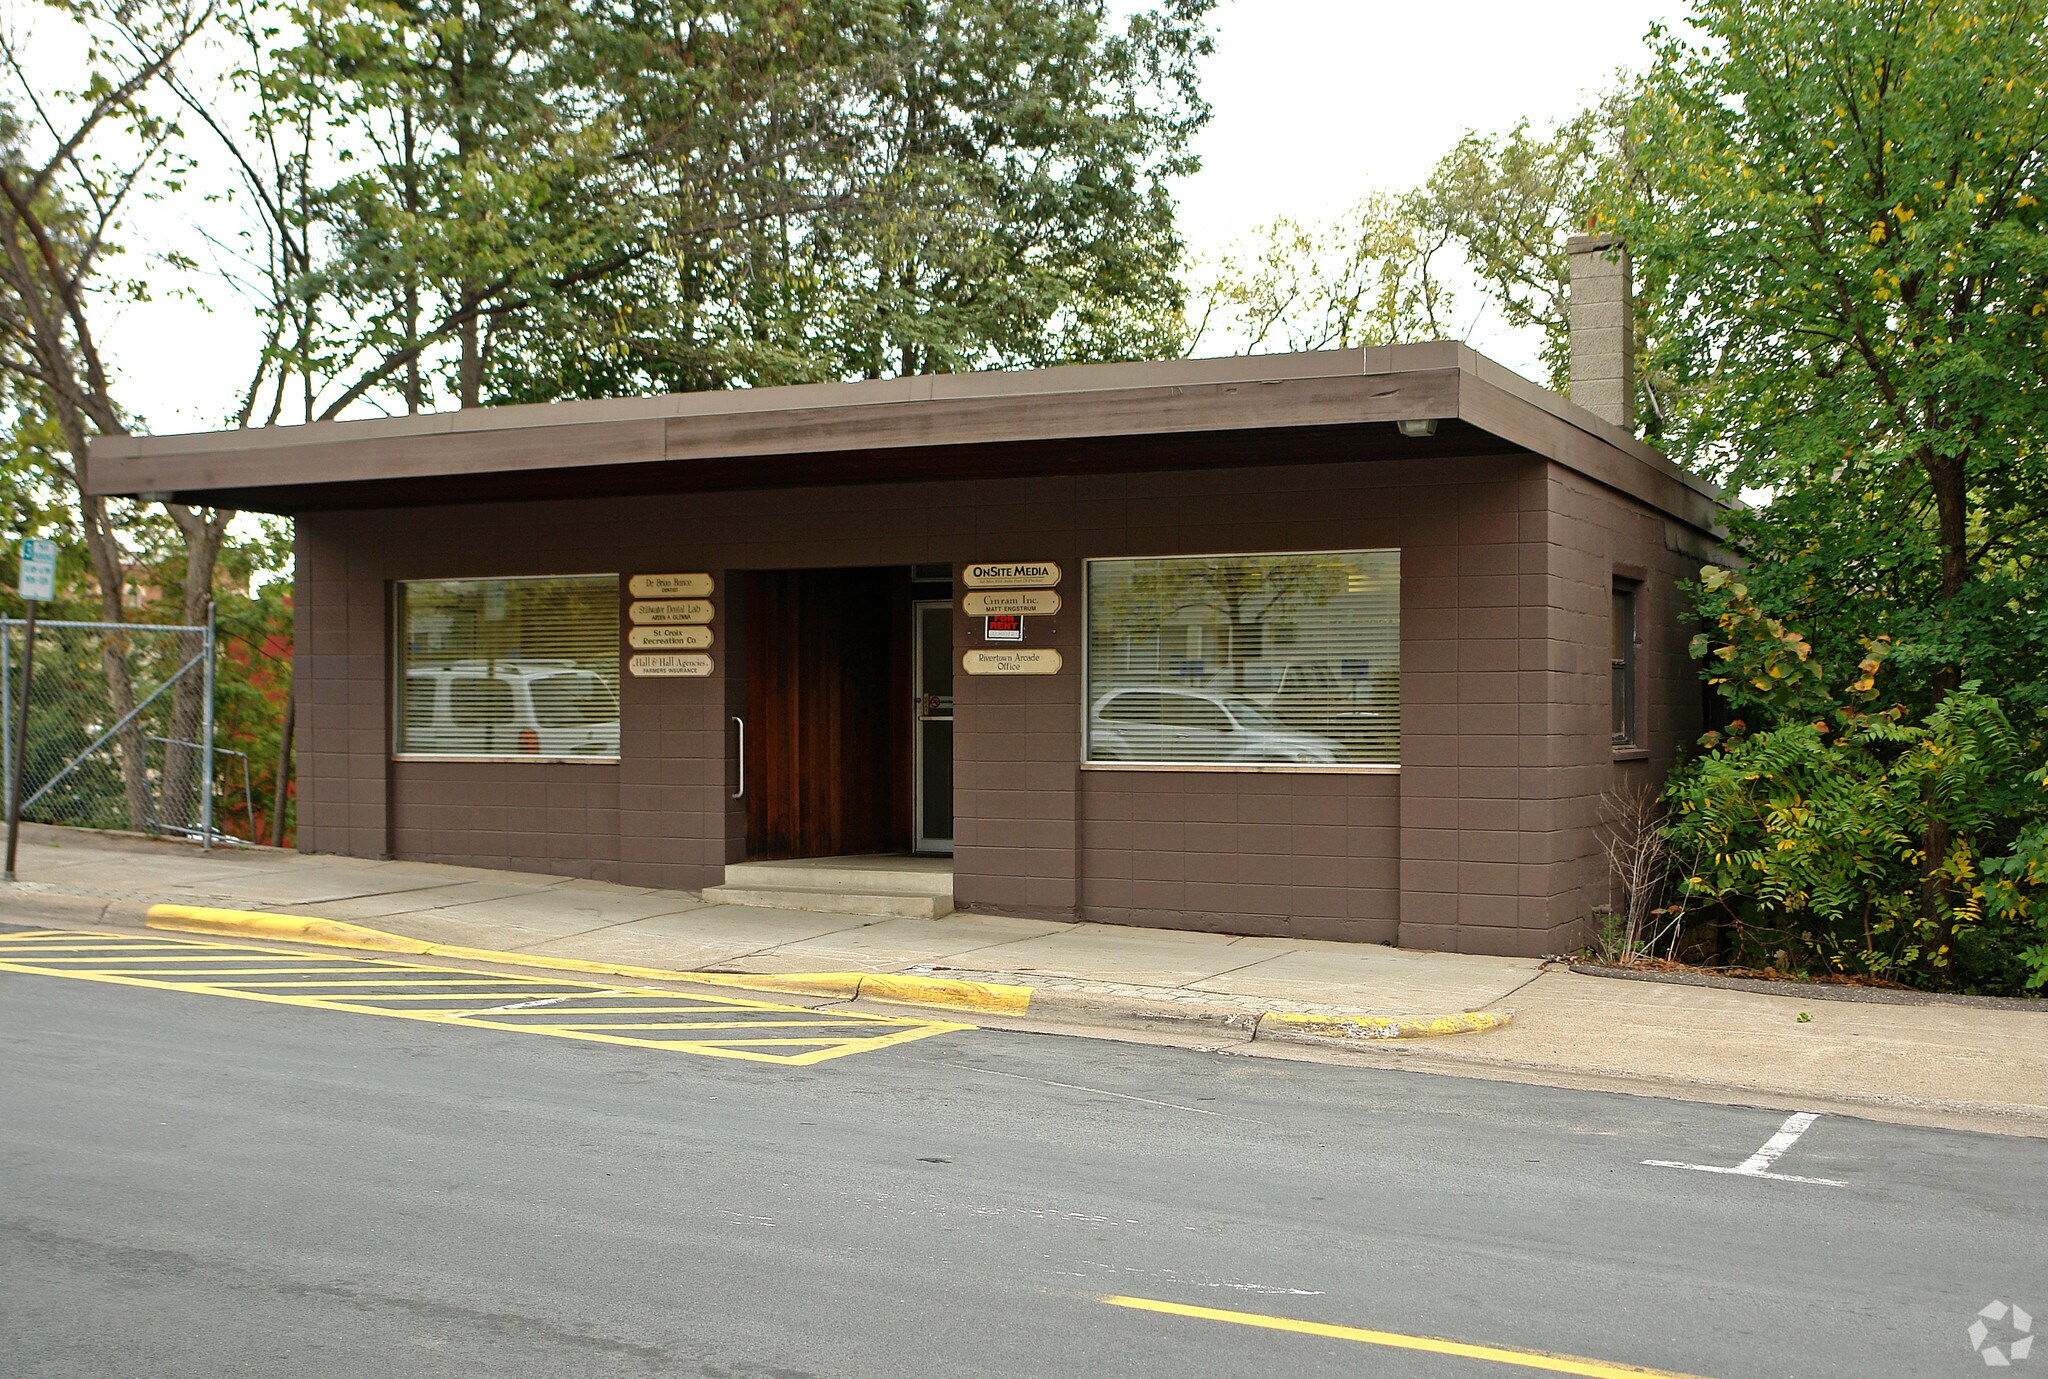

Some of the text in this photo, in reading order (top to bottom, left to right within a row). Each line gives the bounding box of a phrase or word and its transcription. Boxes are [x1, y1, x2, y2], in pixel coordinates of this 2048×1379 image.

[639, 604, 701, 614] Stillwater Dental Lab
[989, 621, 1018, 630] RENT
[643, 637, 684, 645] Recreation
[635, 657, 651, 667] Hall
[652, 657, 658, 666] &
[660, 656, 674, 666] Hall
[978, 653, 1040, 662] Rivertown Arcade
[997, 662, 1020, 671] Office
